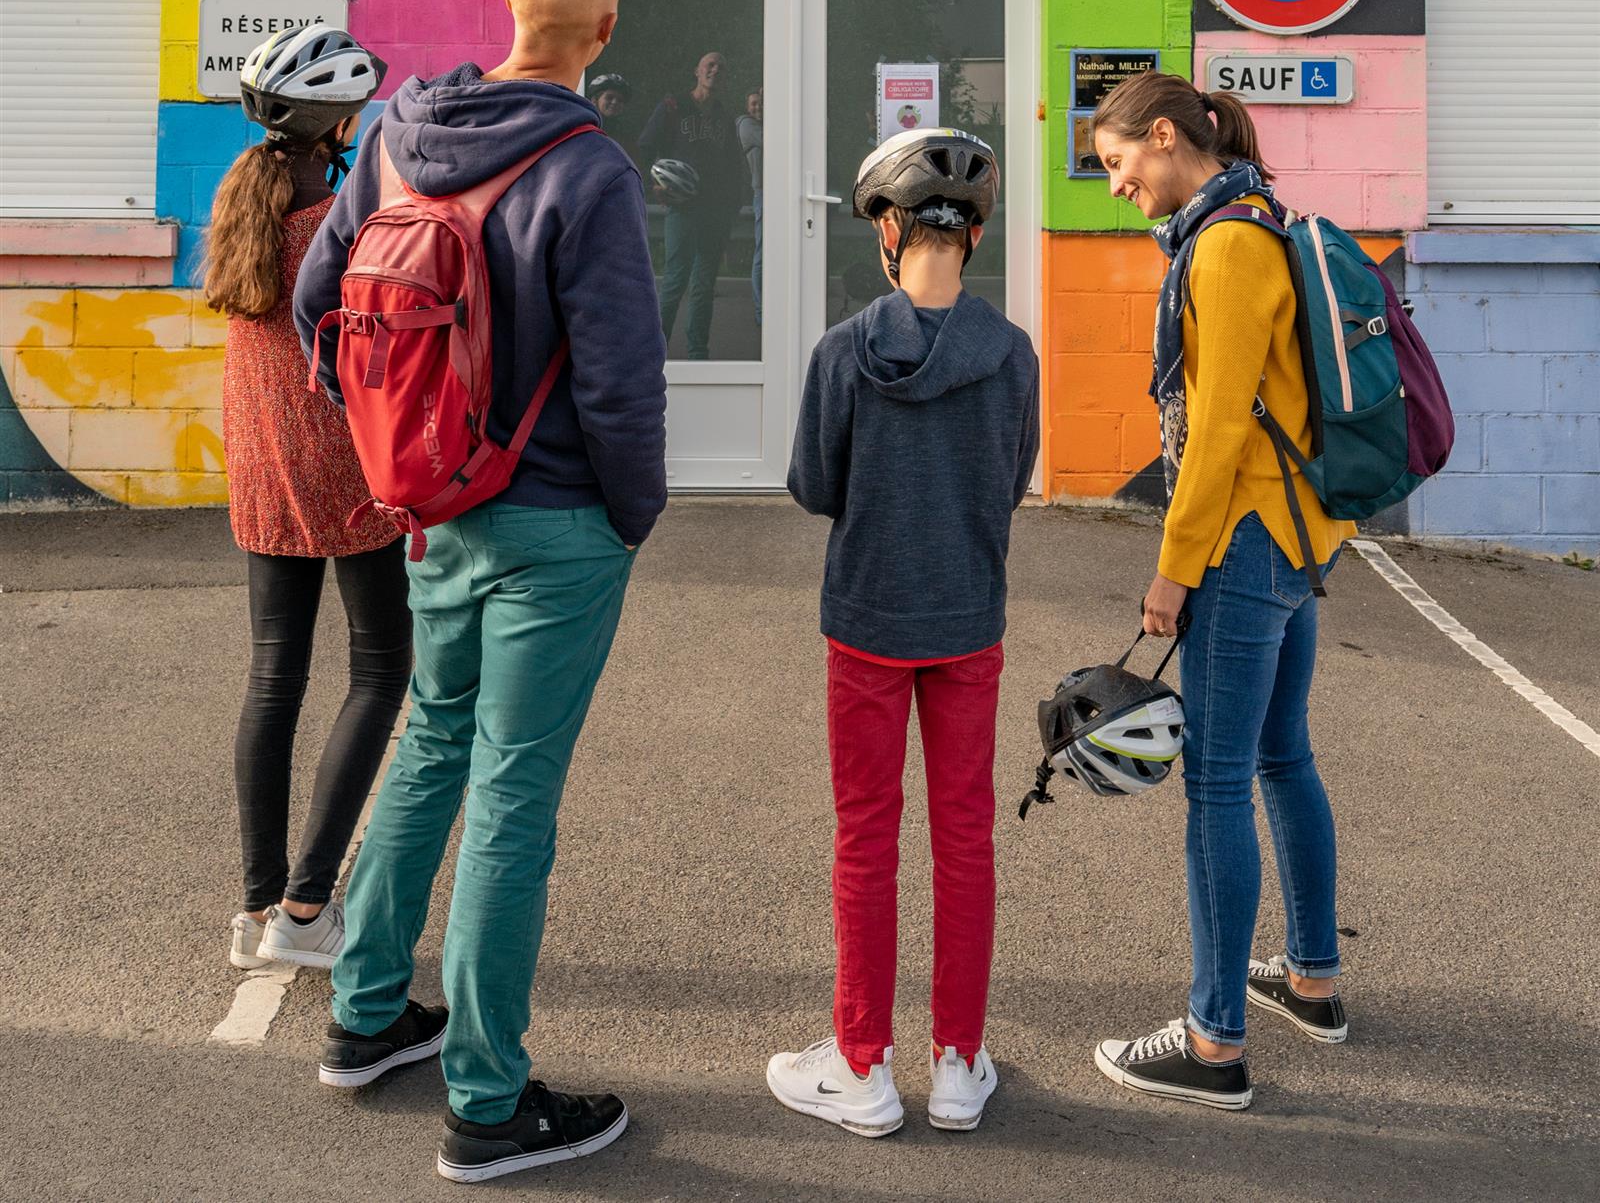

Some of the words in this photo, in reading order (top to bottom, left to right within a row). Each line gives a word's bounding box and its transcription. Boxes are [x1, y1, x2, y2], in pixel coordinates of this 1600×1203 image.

[1079, 62, 1114, 70] Nathalie
[1119, 62, 1151, 70] MILLET
[1218, 67, 1296, 90] SAUF
